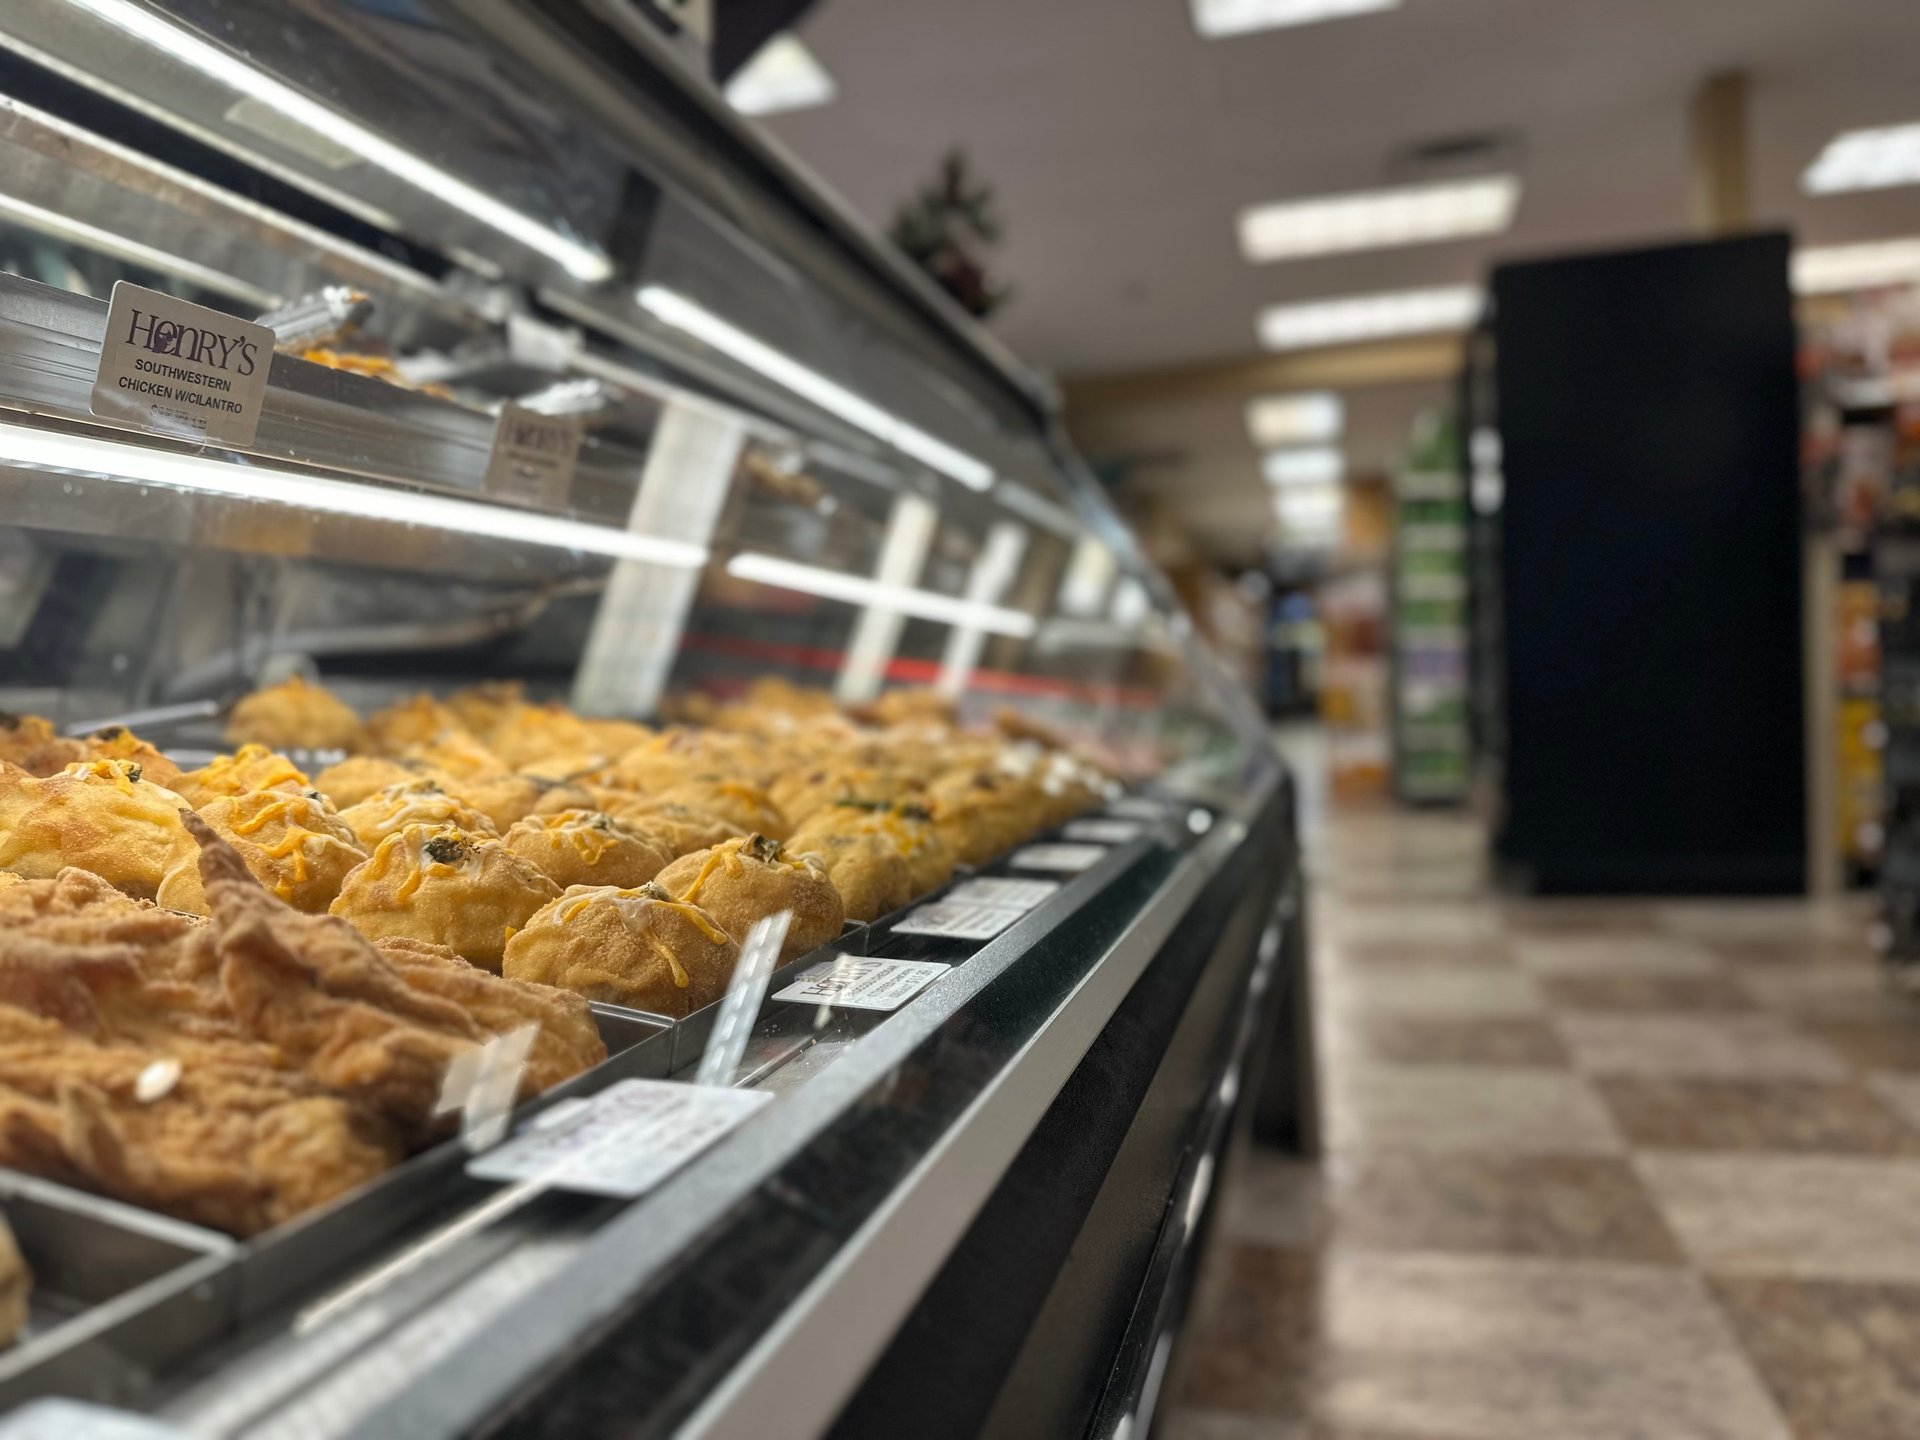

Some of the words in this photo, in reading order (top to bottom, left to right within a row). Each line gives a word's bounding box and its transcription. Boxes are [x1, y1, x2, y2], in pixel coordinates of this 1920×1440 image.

[134, 358, 232, 392] SOUTHWESTERN
[118, 376, 173, 399] CHICKEN
[175, 388, 243, 414] W/CILANTRO
